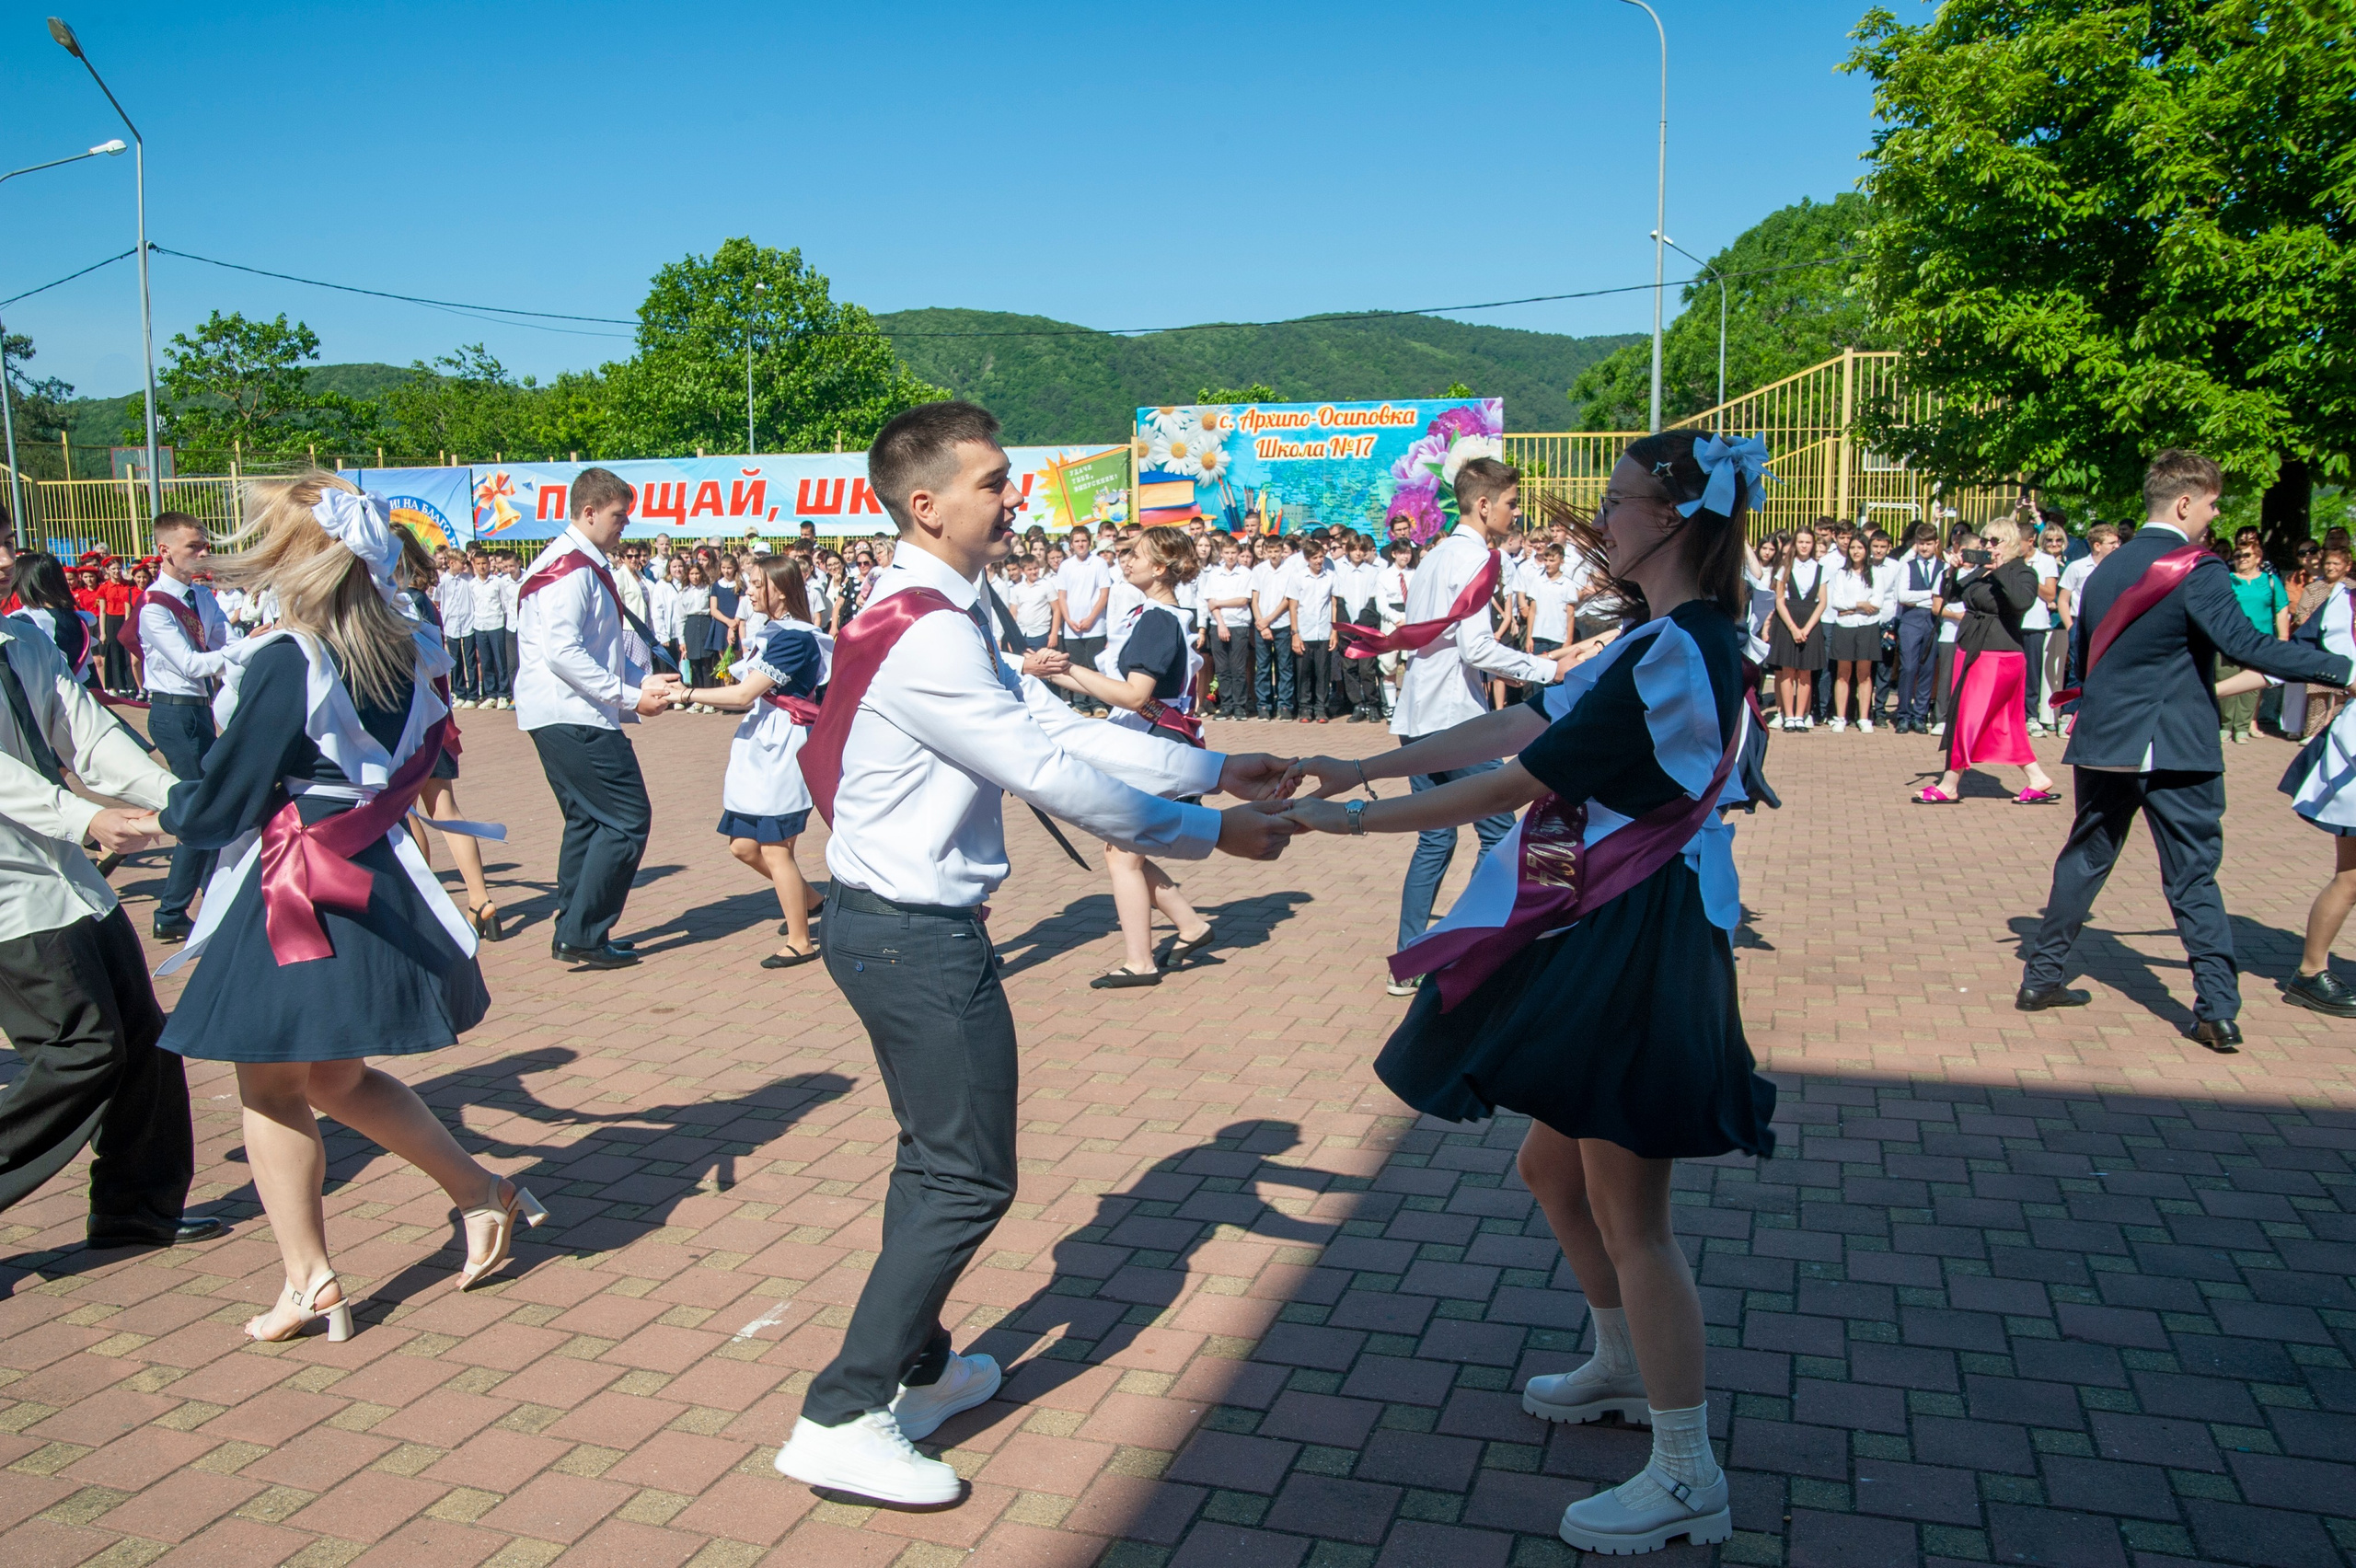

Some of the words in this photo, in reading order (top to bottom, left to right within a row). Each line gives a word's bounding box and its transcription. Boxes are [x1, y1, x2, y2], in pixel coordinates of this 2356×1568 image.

[1219, 415, 1233, 429] с.
[1240, 405, 1415, 433] Архипо-Осиповка
[1255, 438, 1324, 458] Школа
[1330, 437, 1375, 457] №17
[537, 468, 779, 525] ПЩАЙ,
[403, 499, 419, 510] НА
[422, 503, 451, 536] БЛАГО
